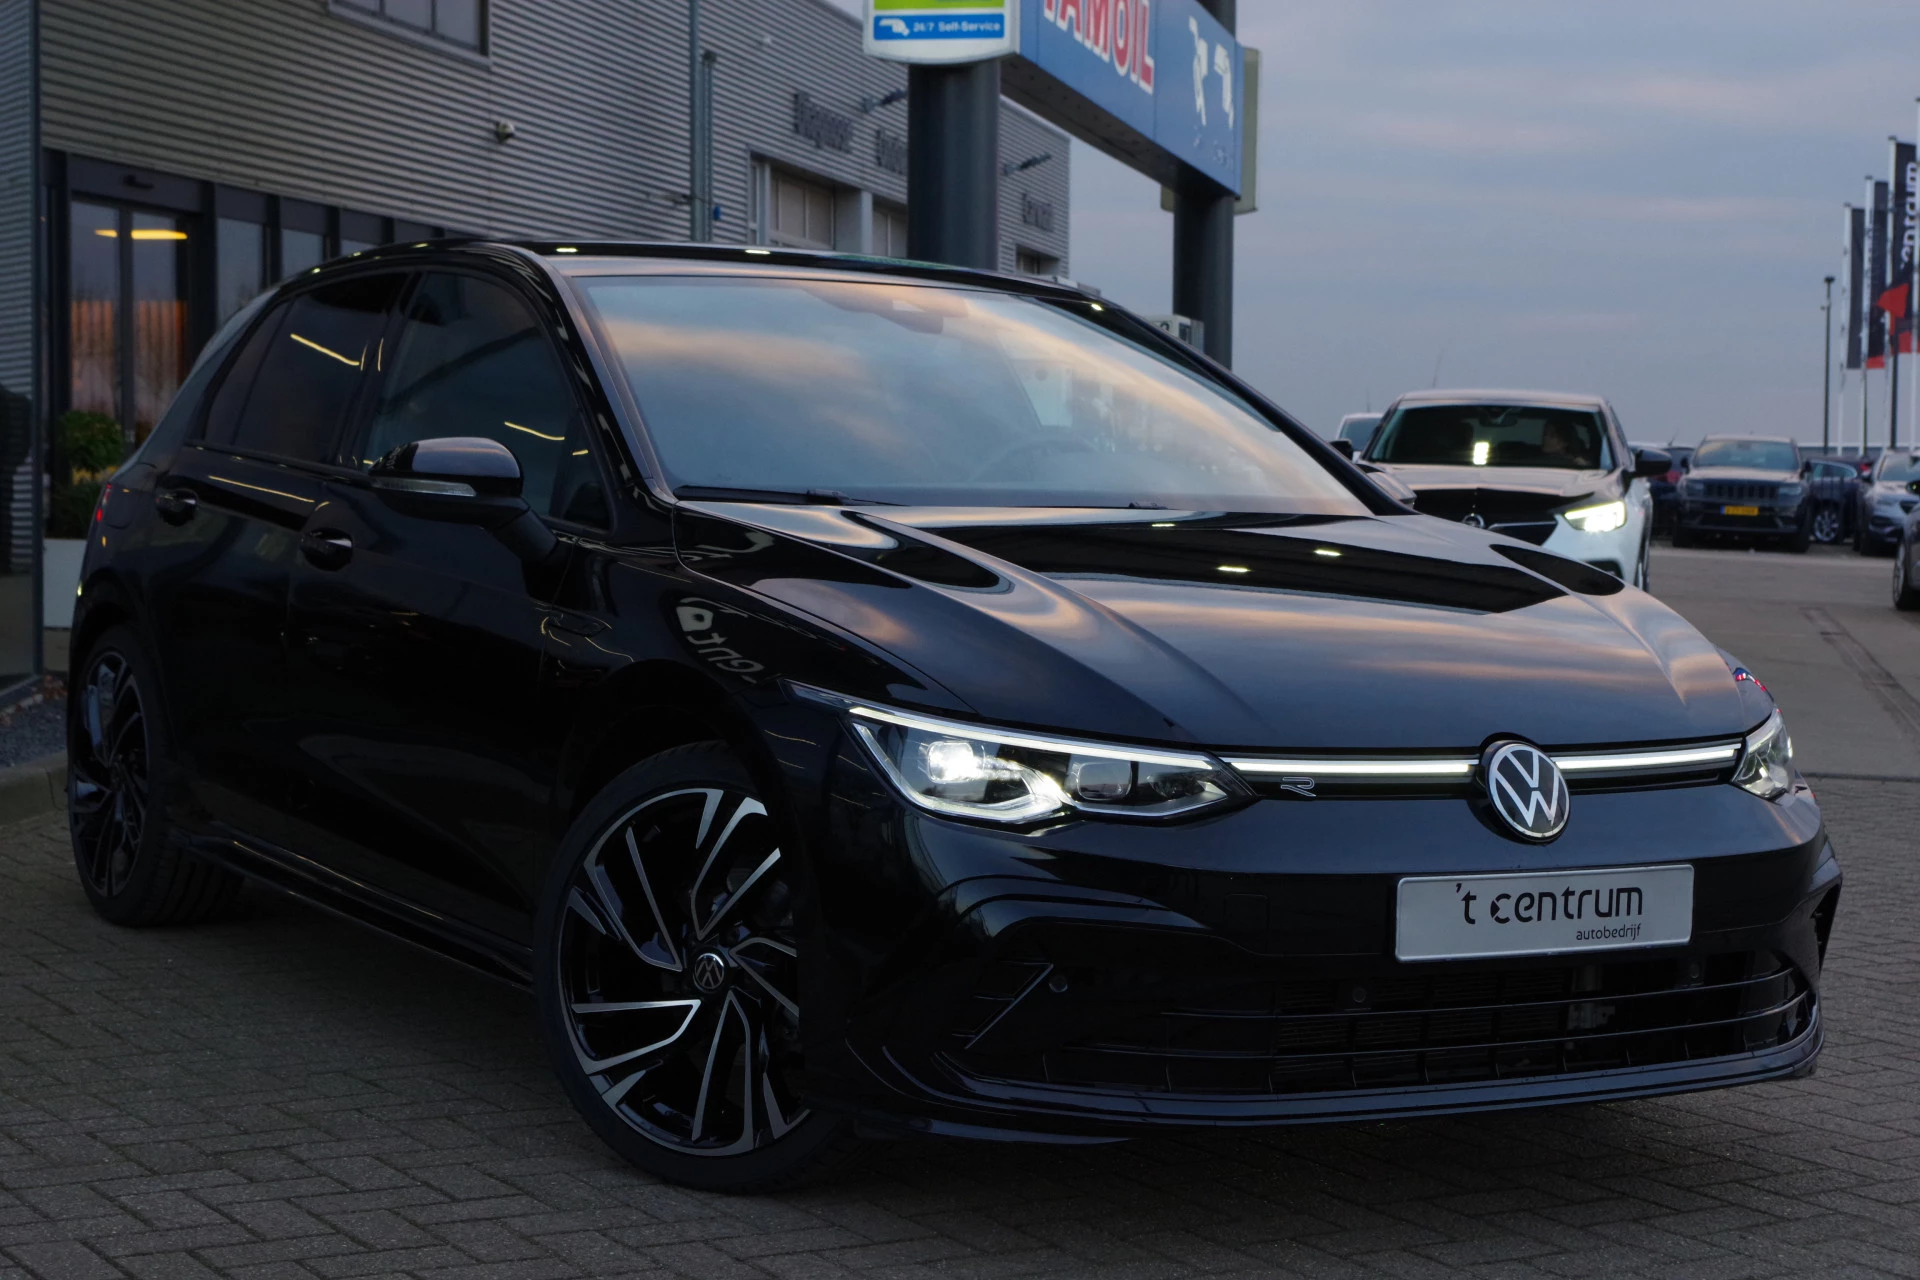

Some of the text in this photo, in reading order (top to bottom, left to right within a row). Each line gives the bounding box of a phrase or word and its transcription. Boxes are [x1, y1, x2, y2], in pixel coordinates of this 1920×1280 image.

[938, 21, 1001, 32] Self-Service
[1456, 882, 1643, 925] 't centrum
[1576, 923, 1642, 941] autobedrijf
